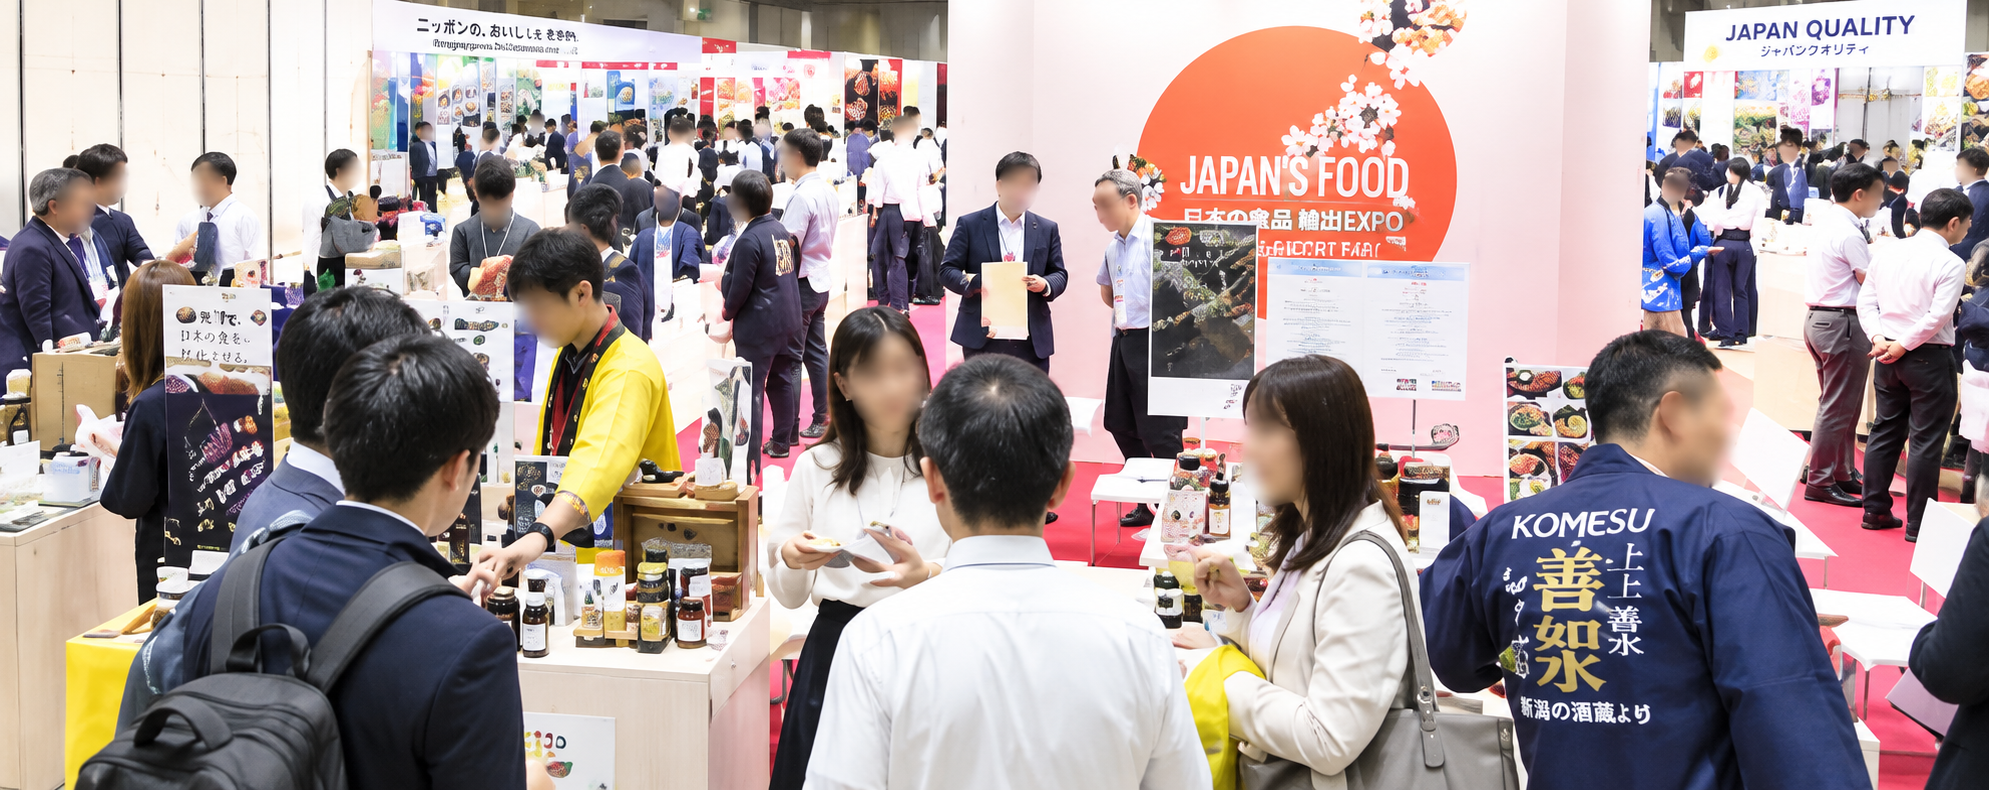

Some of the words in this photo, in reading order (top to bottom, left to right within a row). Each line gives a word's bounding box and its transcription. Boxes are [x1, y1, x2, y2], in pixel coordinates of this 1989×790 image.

[1725, 21, 1799, 41] JAPAN
[1805, 15, 1916, 41] QUALITY
[1180, 155, 1309, 196] JAPAN'S
[1317, 156, 1410, 199] FOOD
[1511, 508, 1656, 539] KOMESU
[1532, 546, 1607, 693] 善如水
[1606, 542, 1645, 656] 上上善水
